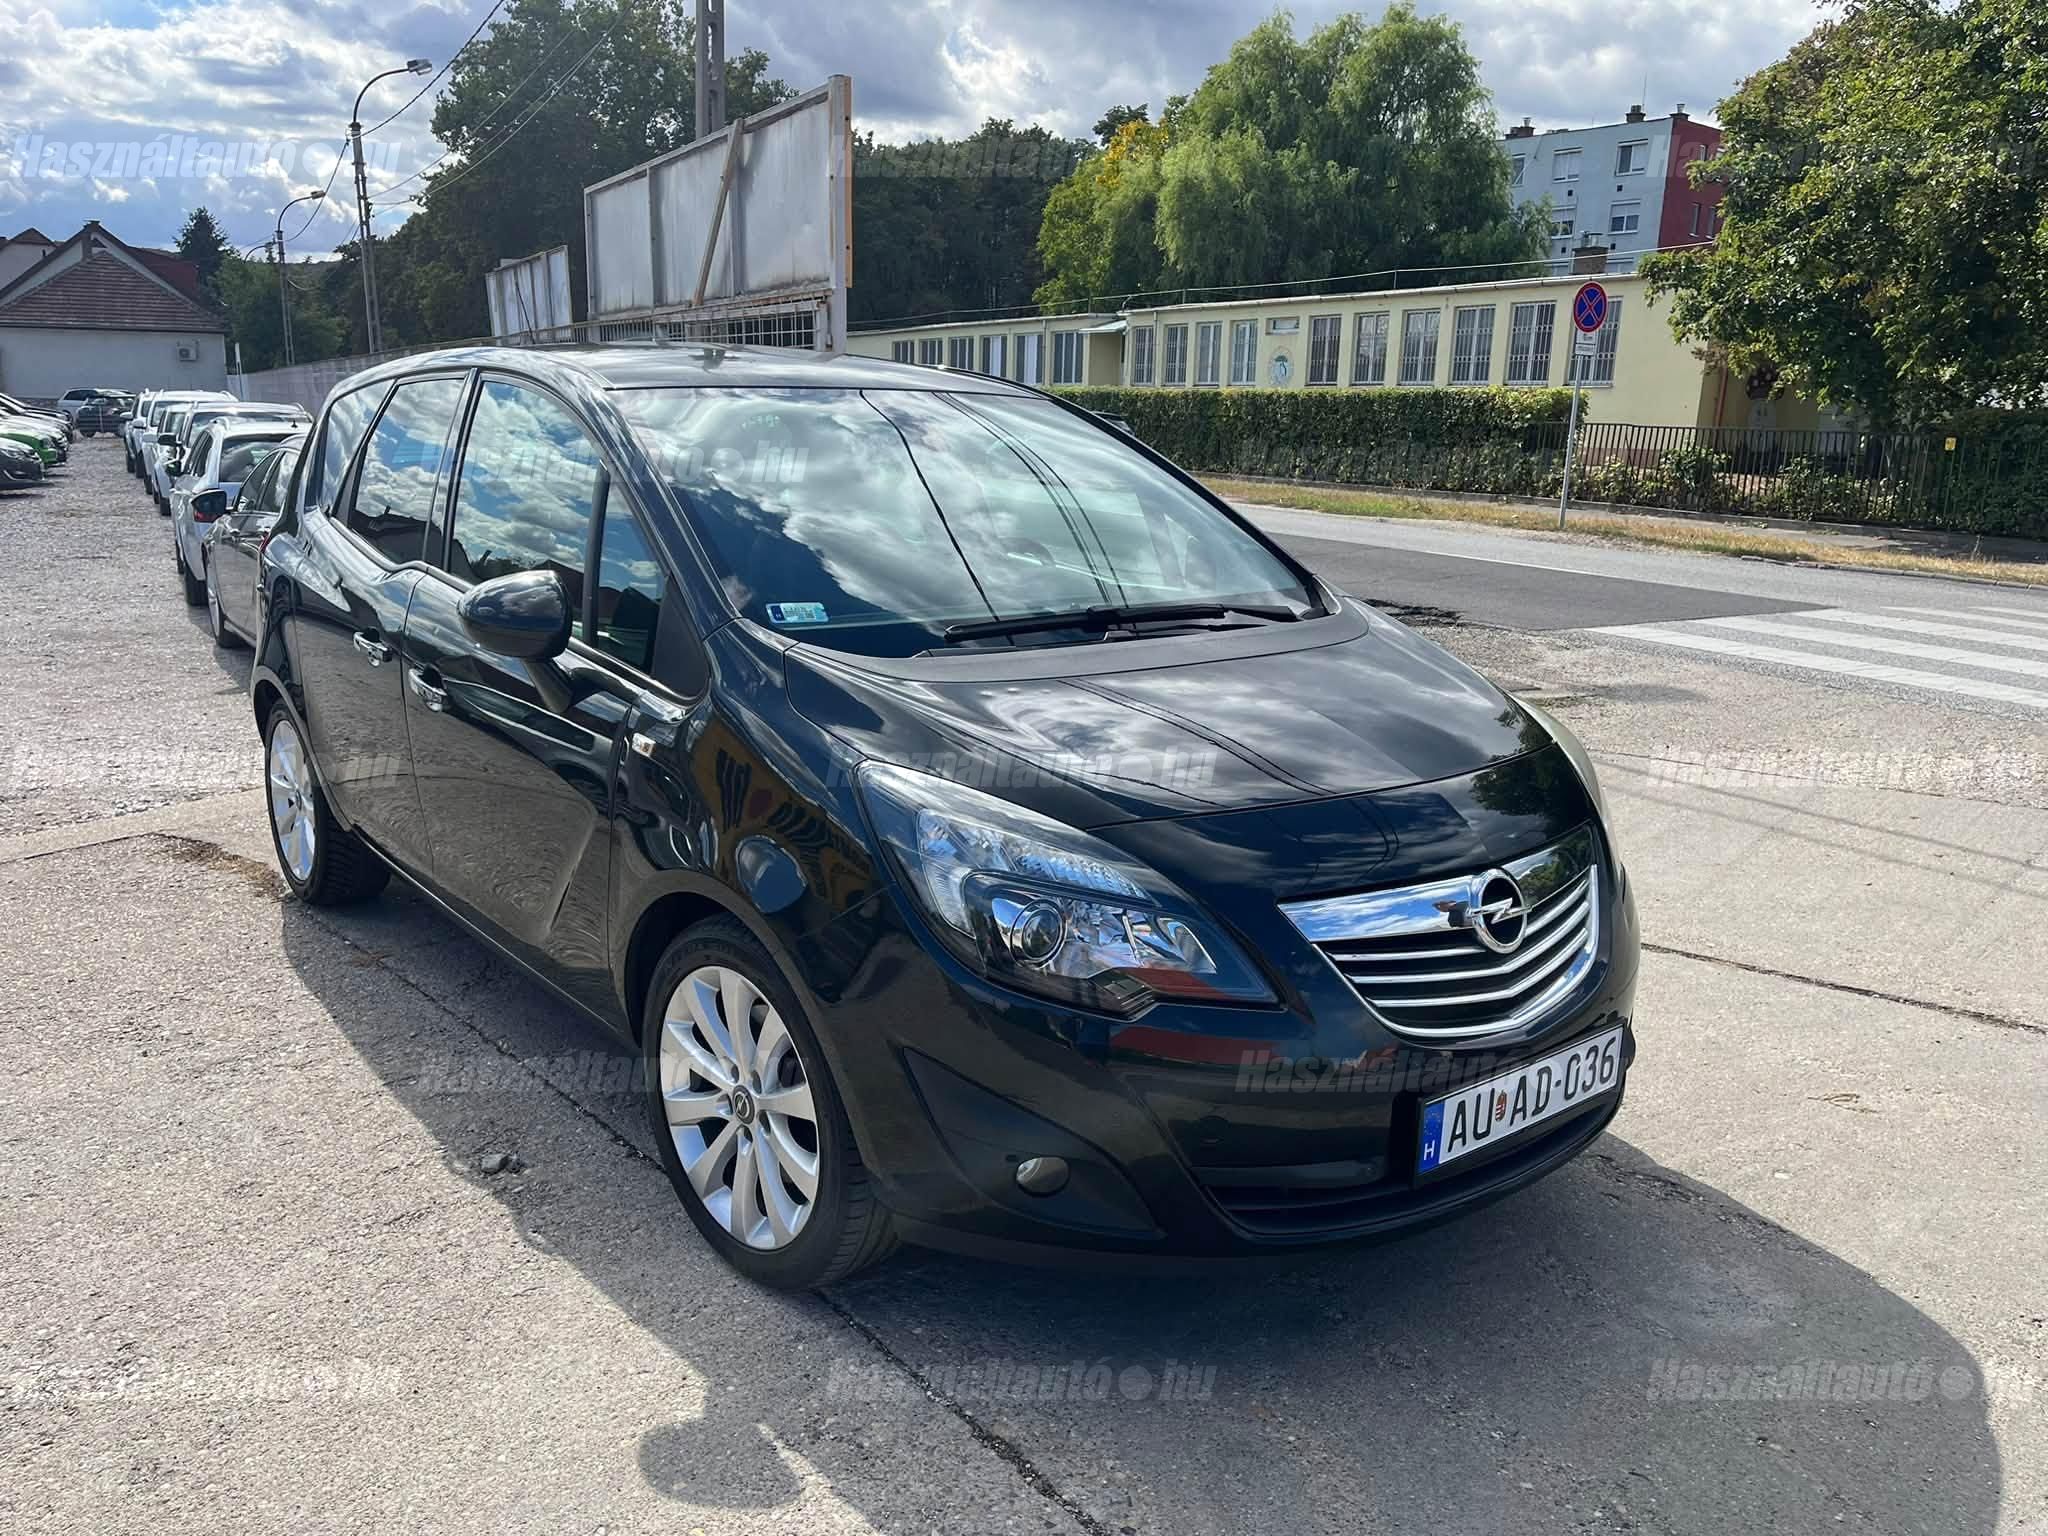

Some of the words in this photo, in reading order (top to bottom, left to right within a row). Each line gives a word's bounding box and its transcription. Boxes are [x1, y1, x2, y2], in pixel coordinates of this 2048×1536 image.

[1448, 1088, 1495, 1153] AU
[1509, 1037, 1617, 1127] AD-036
[1423, 1140, 1435, 1161] H
